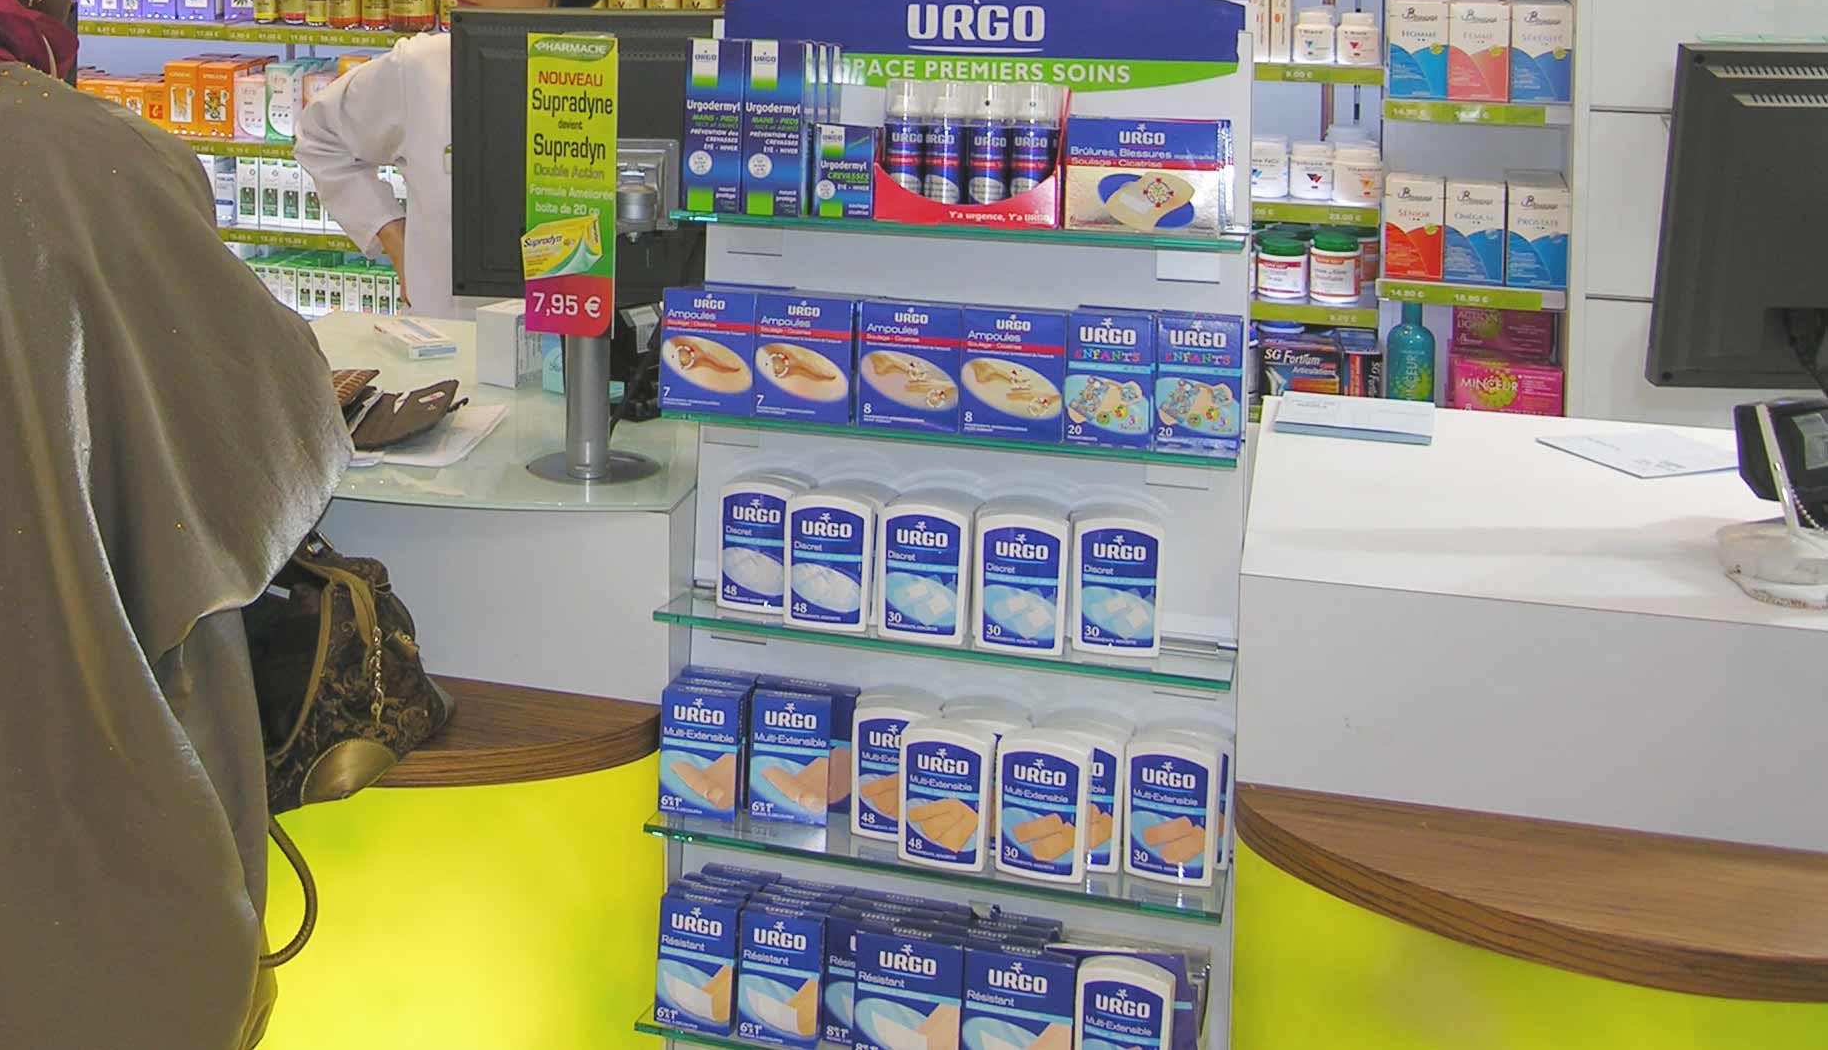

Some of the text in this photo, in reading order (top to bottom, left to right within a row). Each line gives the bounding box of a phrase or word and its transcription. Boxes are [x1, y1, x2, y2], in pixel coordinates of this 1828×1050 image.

[906, 3, 1046, 42] URGO
[536, 41, 607, 55] PHARMACIE
[538, 70, 603, 87] NOUVEAU
[924, 61, 1047, 82] PREMIERS
[1052, 64, 1131, 84] SOINS
[532, 87, 613, 116] Supradyne
[686, 100, 741, 114] Urgodermyl
[1119, 130, 1166, 146] URGO
[533, 133, 606, 165] Supradyn
[1070, 145, 1173, 160] Brûlures, Blessures
[533, 163, 605, 181] Double Action
[560, 202, 572, 215] de
[573, 203, 587, 216] 20
[532, 291, 602, 319] 7,95 €
[693, 298, 726, 311] URGO
[667, 308, 716, 322] Ampoules
[1078, 325, 1136, 346] URGO
[1076, 347, 1141, 362] ENFANTS
[1264, 347, 1282, 361] SG
[1068, 424, 1083, 437] 20
[896, 528, 949, 548] URGO
[887, 550, 916, 562] Discret
[887, 611, 903, 624] 30
[673, 705, 726, 725] URGO
[663, 726, 735, 743] Multi-Extensible
[908, 836, 923, 850] 48
[879, 951, 937, 977] URGO
[858, 970, 905, 989] Résistant
[1085, 1014, 1152, 1038] Multi-Extensible
